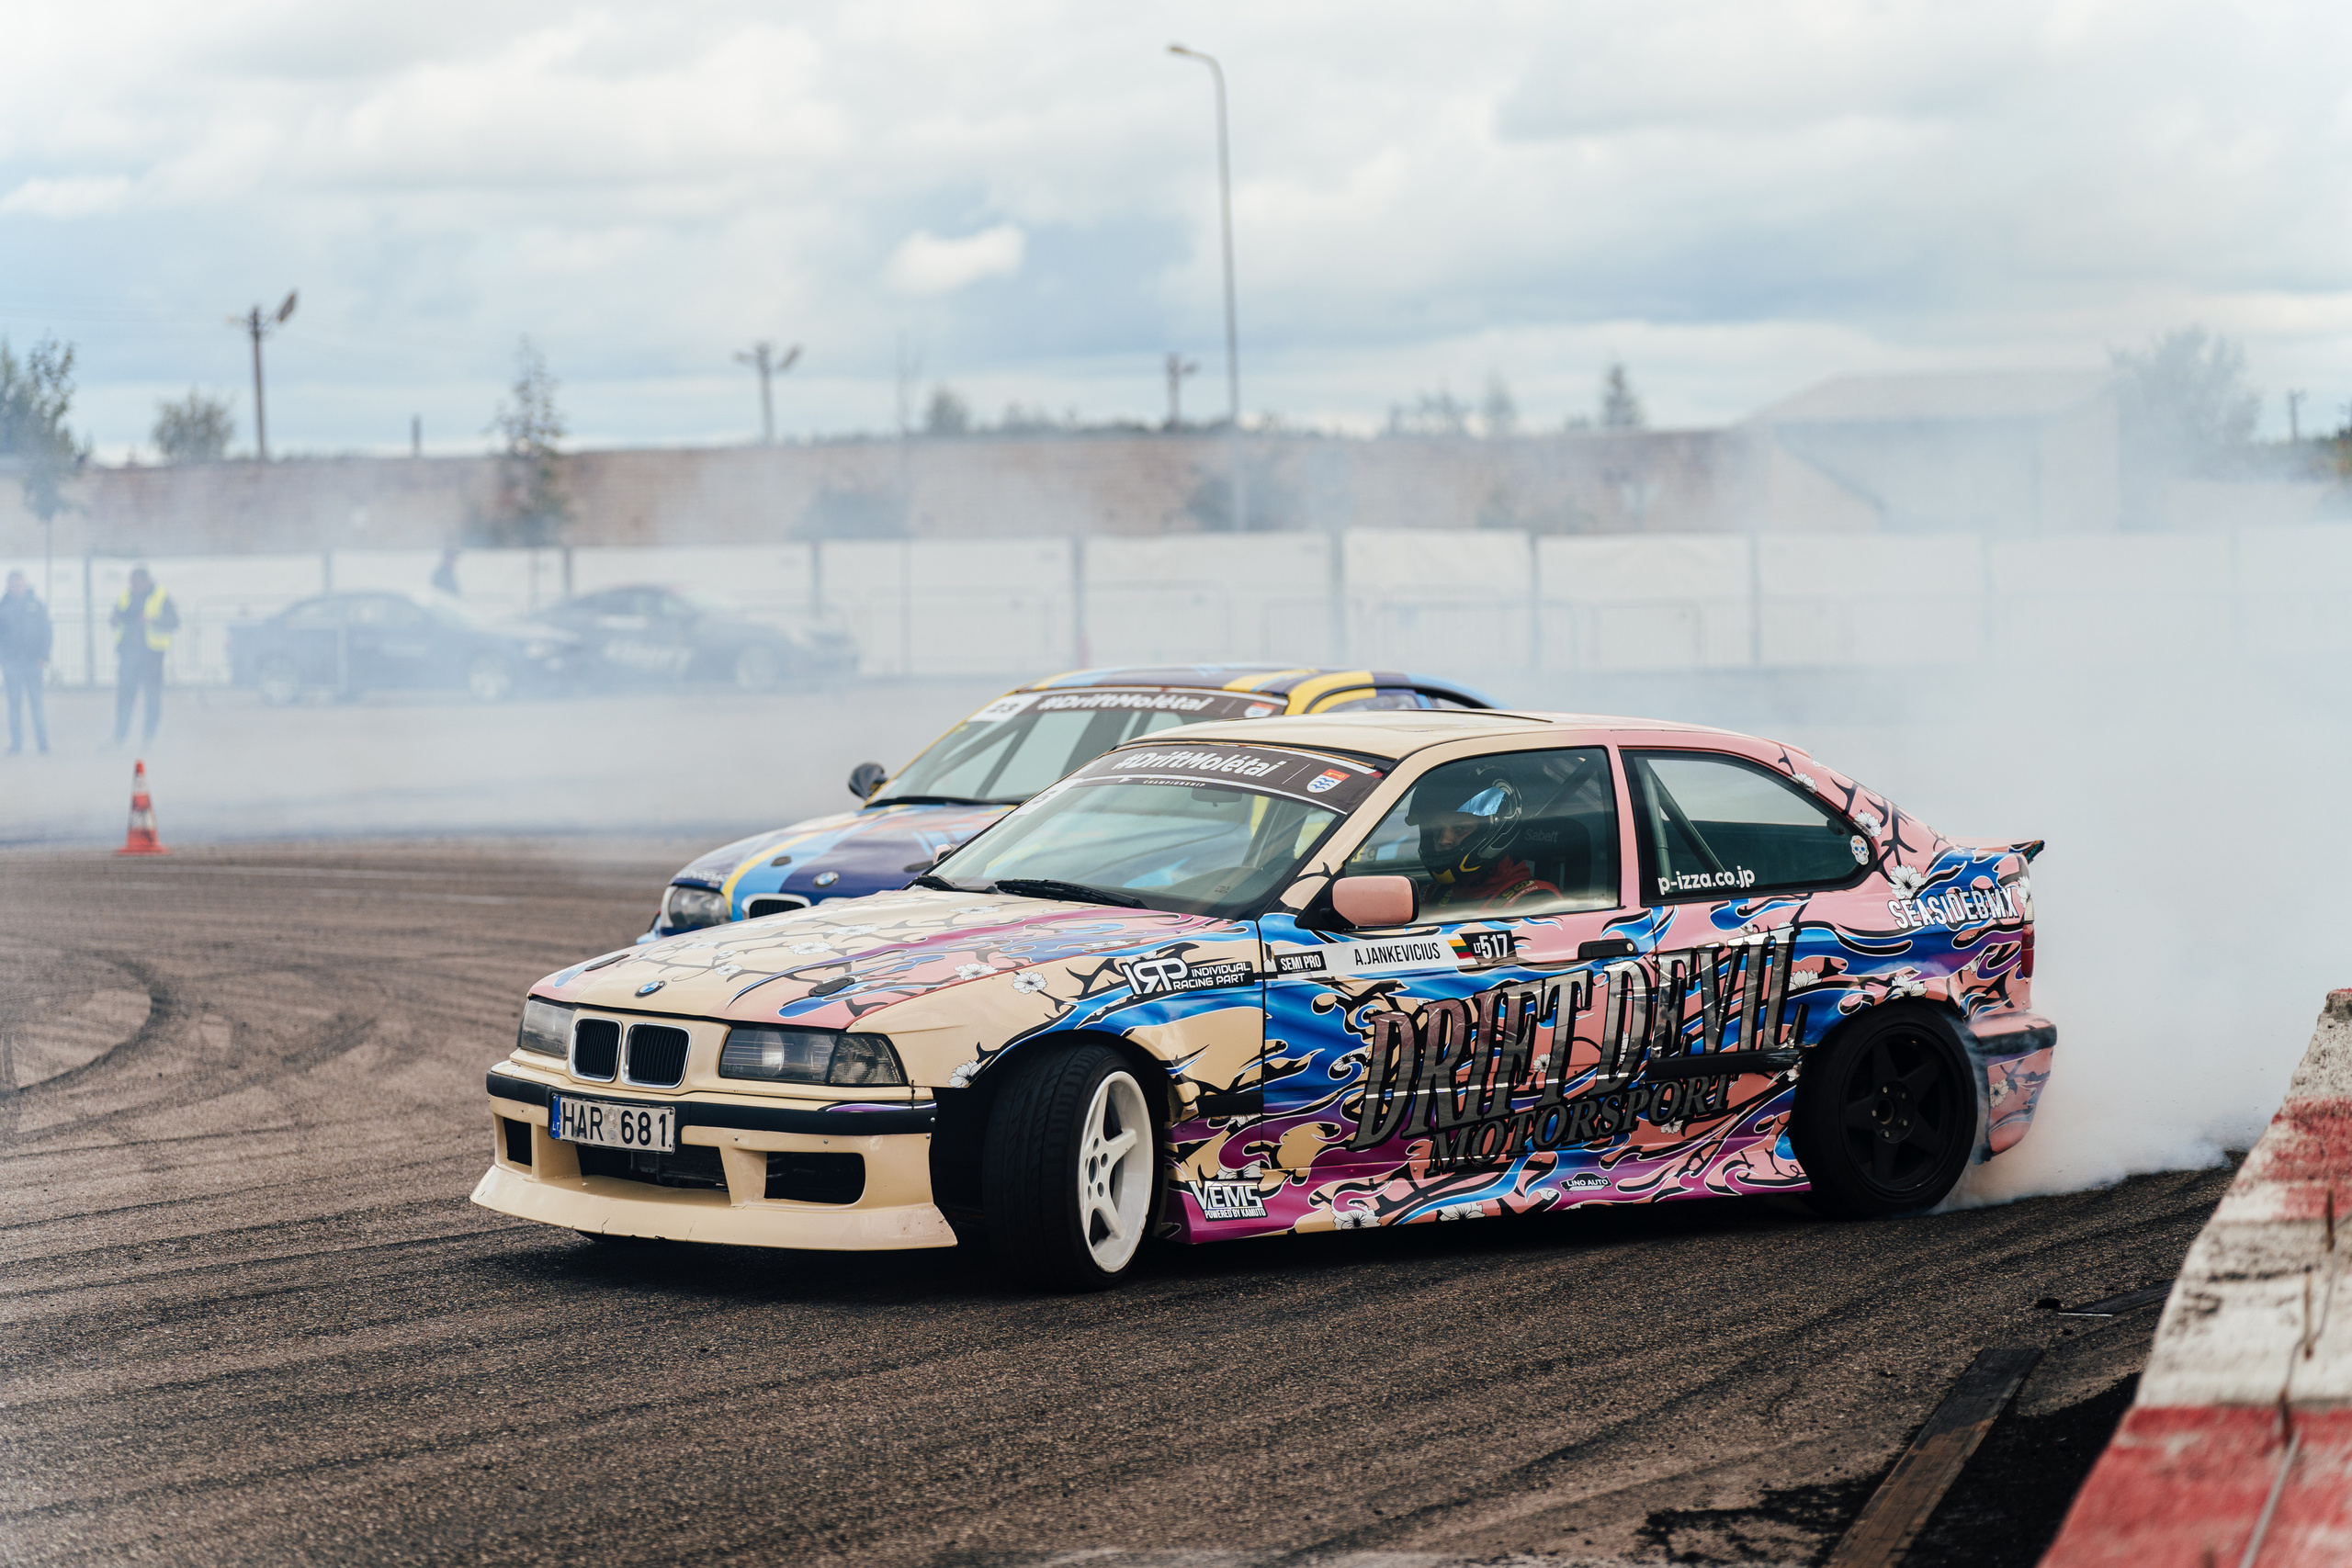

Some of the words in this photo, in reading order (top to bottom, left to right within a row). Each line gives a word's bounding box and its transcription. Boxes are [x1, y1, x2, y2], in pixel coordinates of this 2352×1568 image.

[1657, 866, 1756, 896] p-izza.co.jp
[1888, 886, 2018, 930] SEASIDEBMX
[1354, 942, 1441, 966] A.JANKEVICIUS
[1480, 933, 1509, 959] 517
[1191, 962, 1251, 978] INDIVIDUAL
[1280, 956, 1303, 971] SEMI
[1303, 954, 1322, 969] PRO
[1172, 976, 1214, 990] RACING
[1216, 973, 1245, 985] PART
[1351, 970, 1591, 1150] DRIFT
[1602, 926, 1808, 1095] DEVIL
[562, 1101, 604, 1142] HAR
[621, 1110, 666, 1147] 681
[1428, 1070, 1739, 1175] MOTORSPORT
[1189, 1180, 1263, 1210] VEMS
[1205, 1210, 1232, 1219] POWERED
[1233, 1209, 1241, 1217] BY
